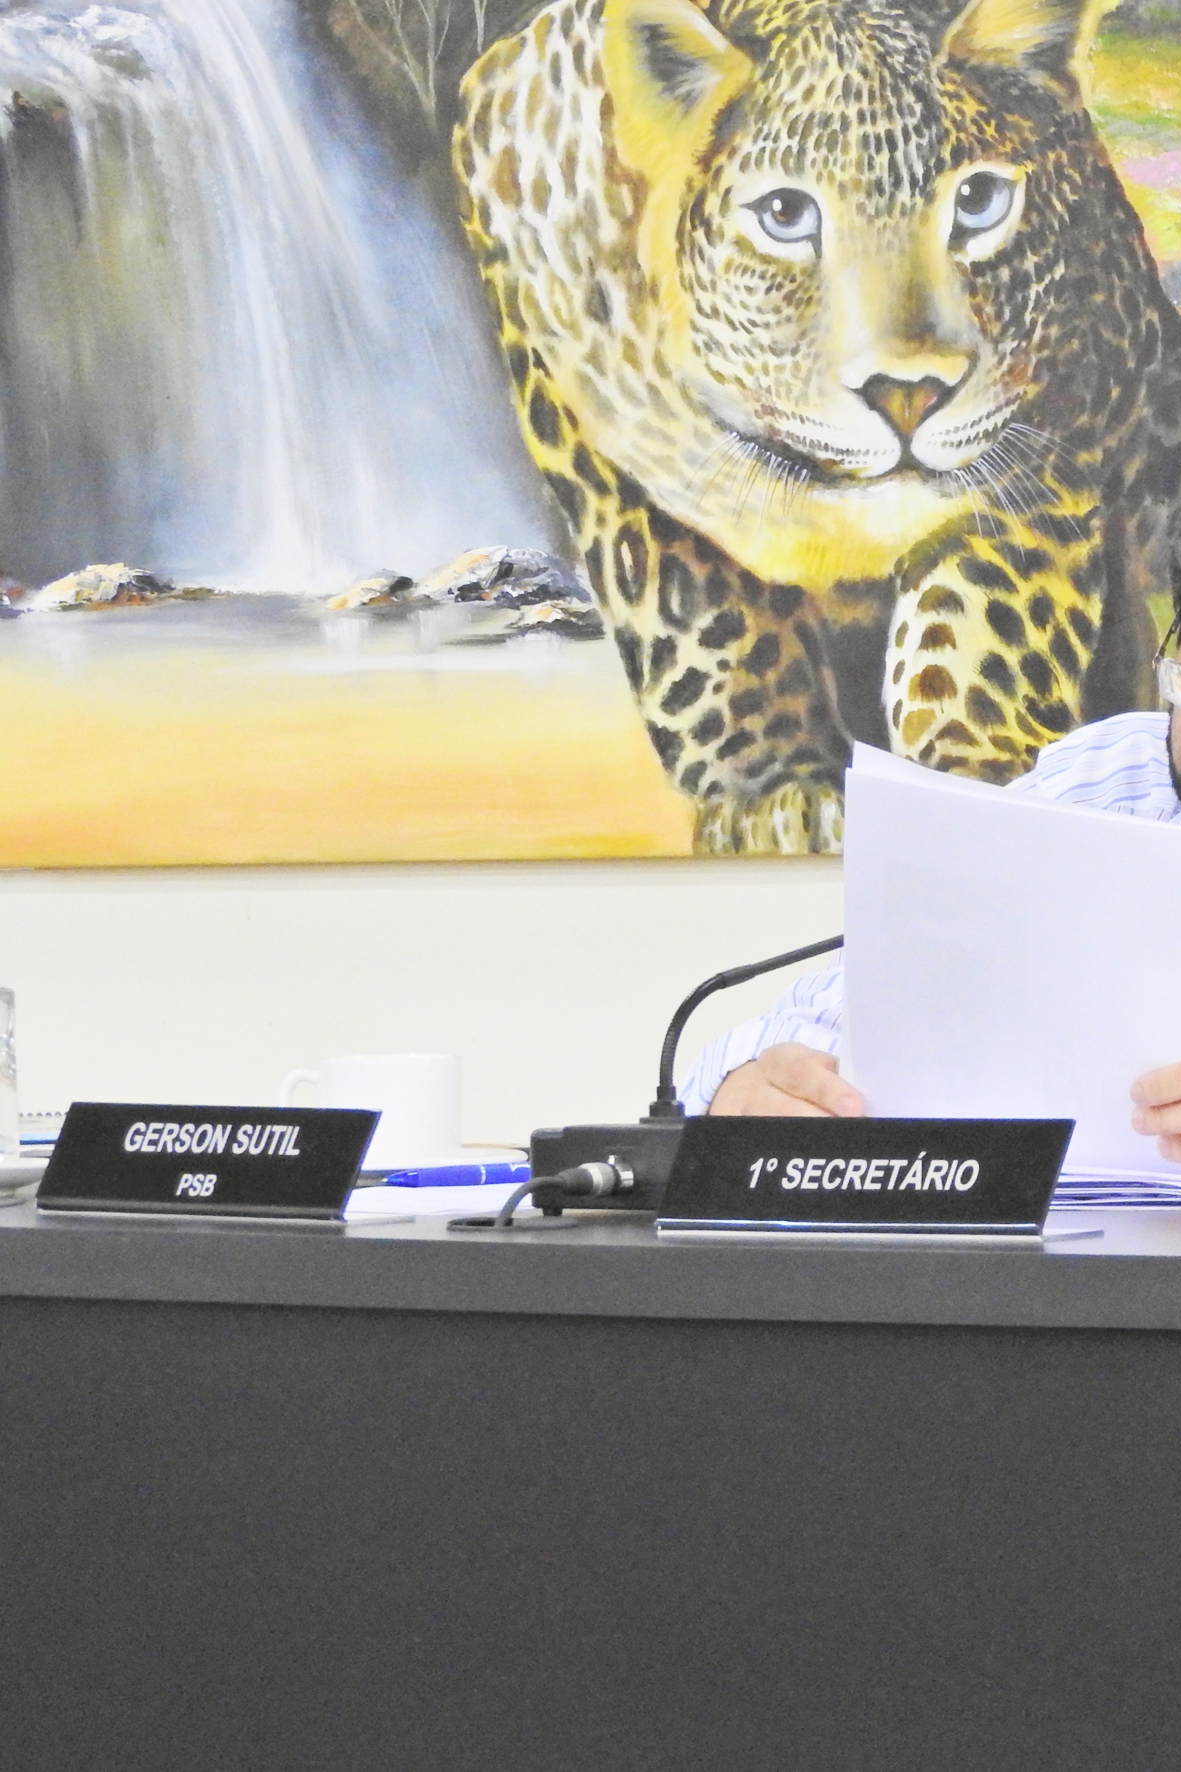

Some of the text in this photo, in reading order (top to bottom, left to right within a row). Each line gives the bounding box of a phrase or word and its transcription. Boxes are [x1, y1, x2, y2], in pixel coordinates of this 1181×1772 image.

[124, 1121, 301, 1156] GERSON SUTIL
[175, 1173, 218, 1197] PSB
[781, 1150, 980, 1191] SECRETÁRIO
